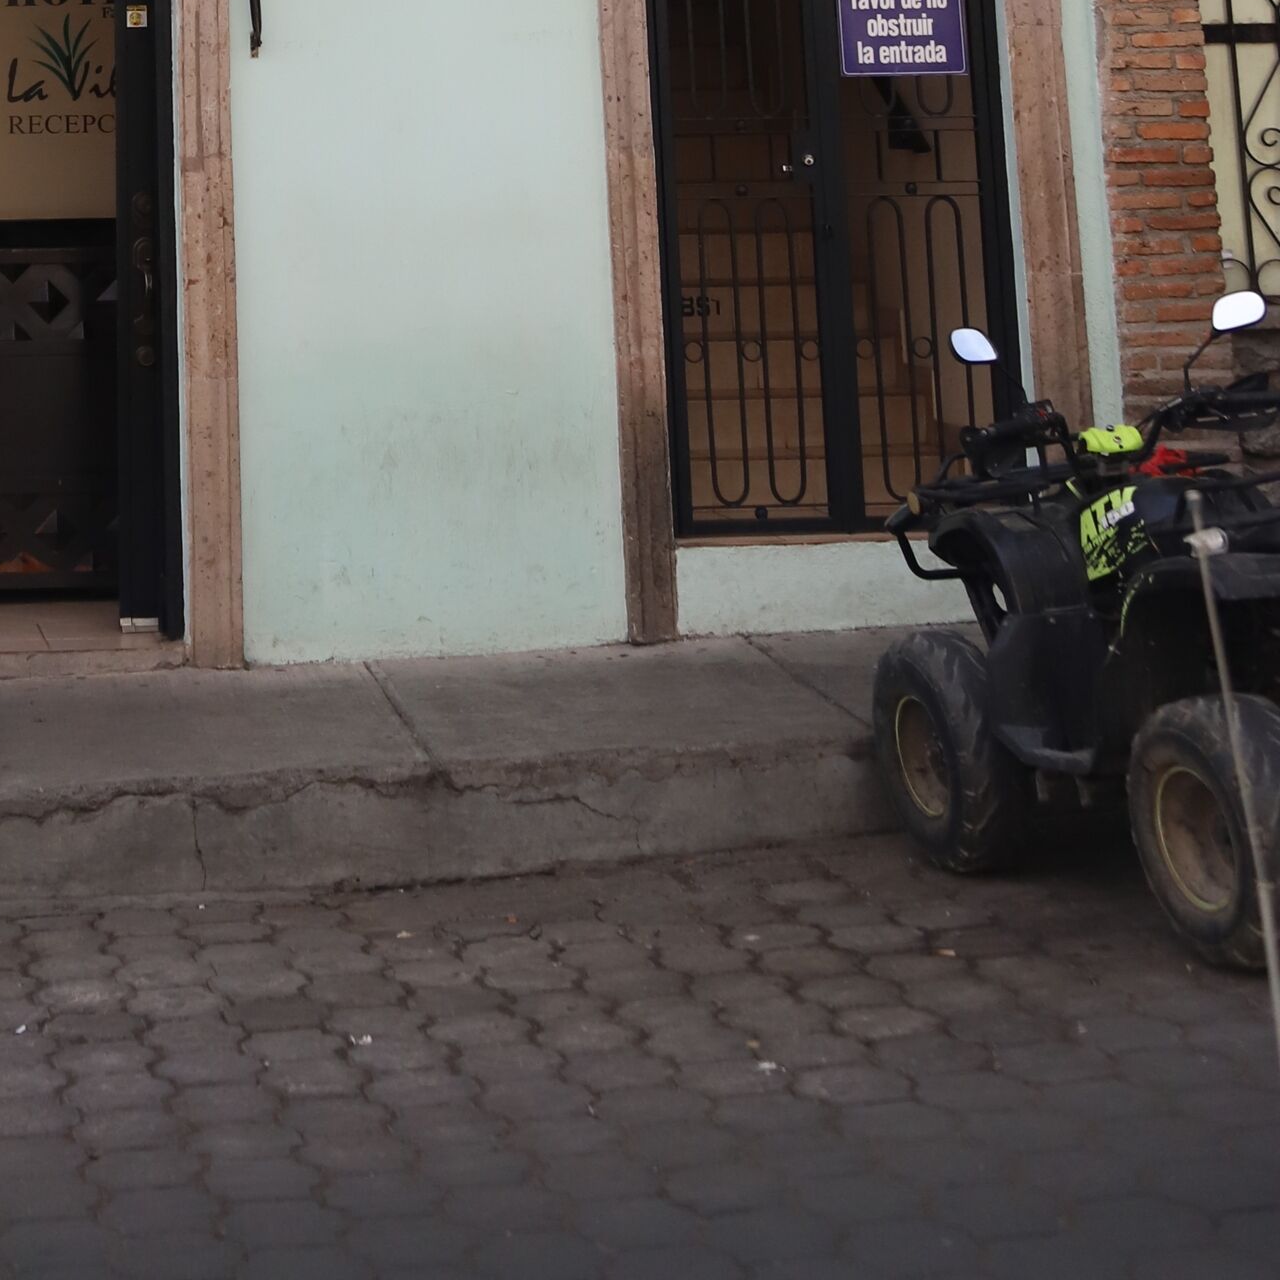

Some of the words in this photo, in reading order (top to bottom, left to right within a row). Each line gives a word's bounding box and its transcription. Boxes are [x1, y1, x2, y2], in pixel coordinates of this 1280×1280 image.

[867, 13, 934, 37] obstruir
[857, 41, 875, 64] la
[879, 40, 947, 64] entrada
[7, 58, 48, 103] La
[1080, 485, 1138, 549] ATV
